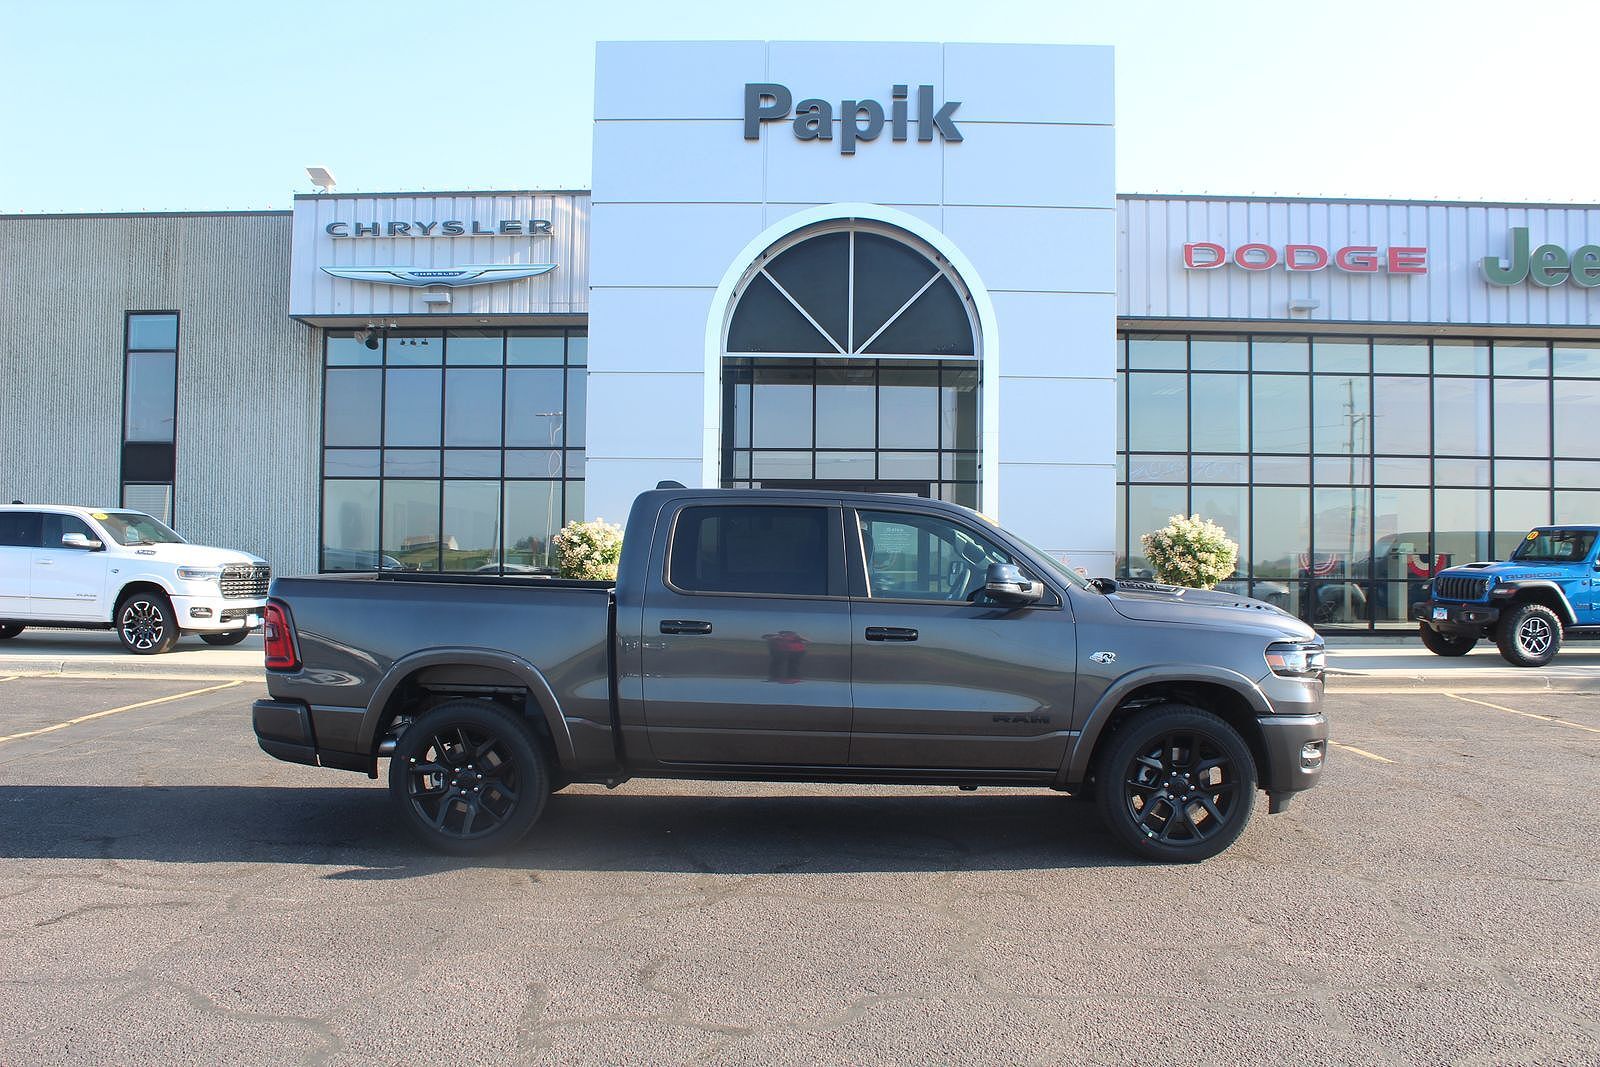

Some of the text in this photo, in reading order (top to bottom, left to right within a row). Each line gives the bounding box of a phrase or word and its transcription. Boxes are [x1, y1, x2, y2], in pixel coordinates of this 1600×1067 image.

[744, 83, 964, 156] Papik
[326, 220, 554, 237] CHRYSLER
[1183, 242, 1428, 274] DODGE
